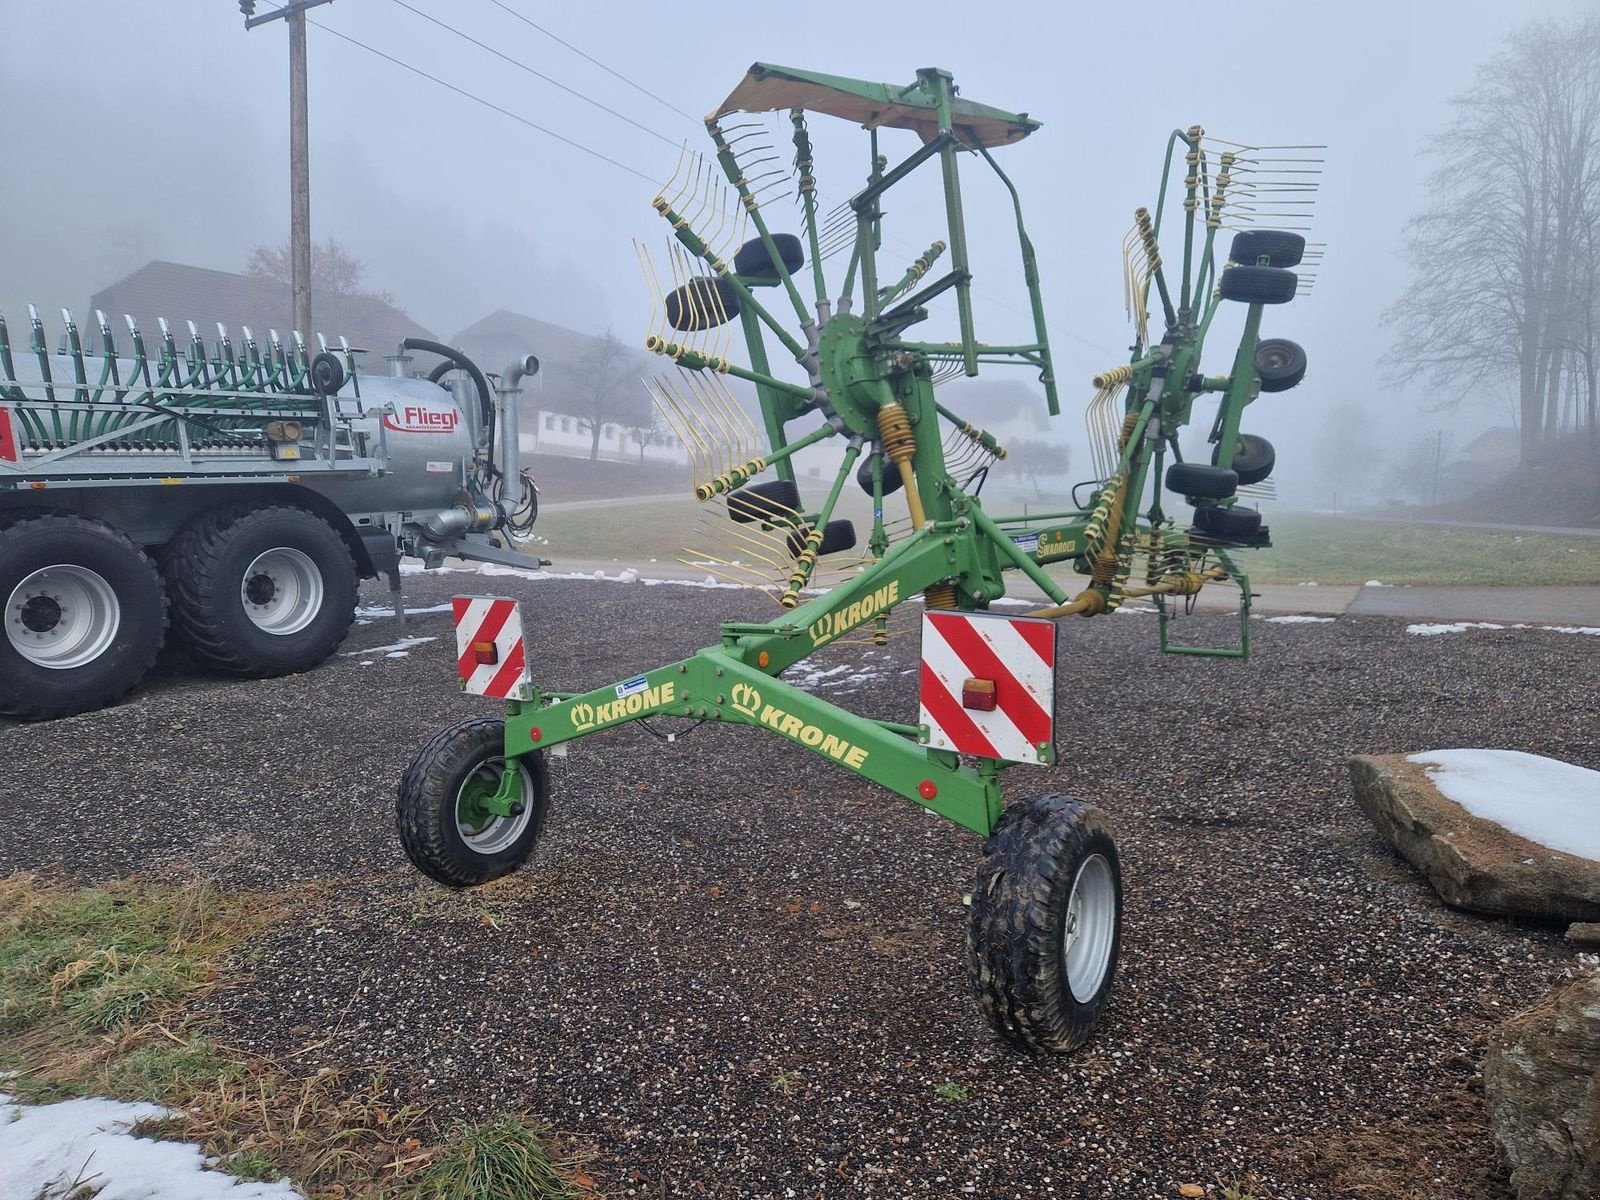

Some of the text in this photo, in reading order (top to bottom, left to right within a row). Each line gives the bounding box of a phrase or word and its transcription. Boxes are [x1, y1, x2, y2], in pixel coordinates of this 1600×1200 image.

[405, 407, 458, 429] Fliegl
[832, 580, 898, 635] KRONE
[596, 681, 675, 725] KRONE
[760, 704, 869, 769] KRONE
